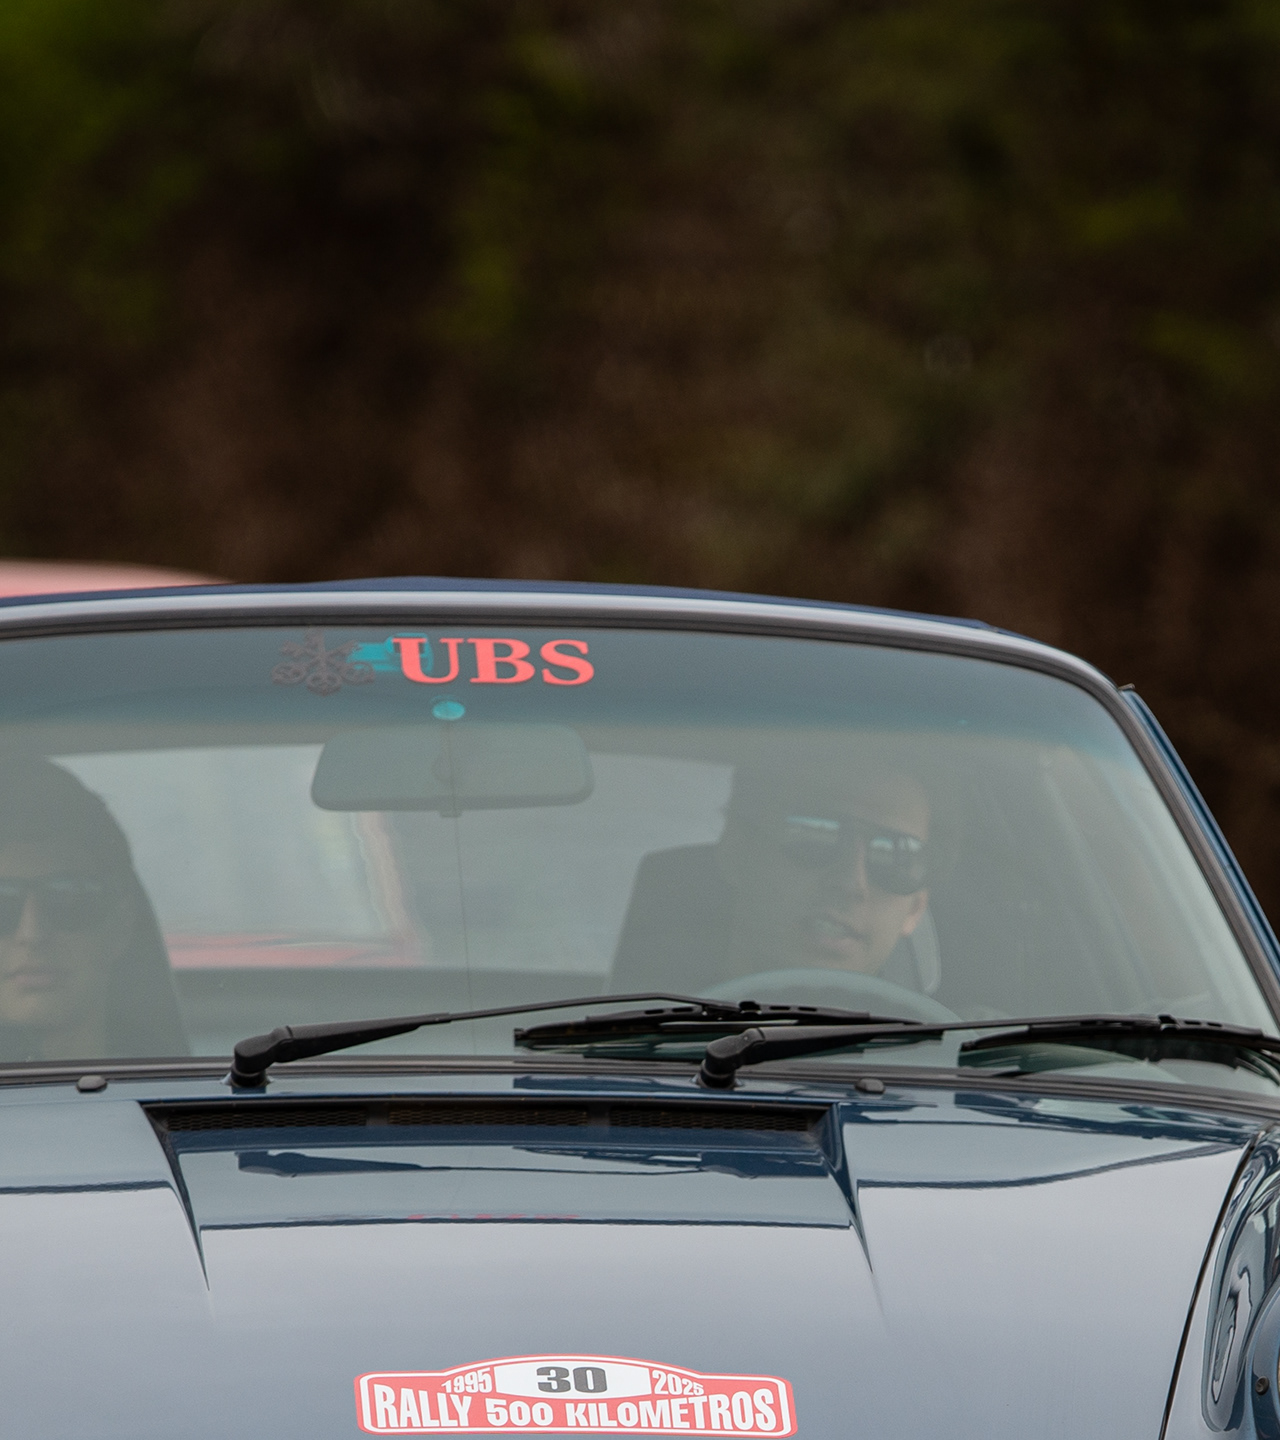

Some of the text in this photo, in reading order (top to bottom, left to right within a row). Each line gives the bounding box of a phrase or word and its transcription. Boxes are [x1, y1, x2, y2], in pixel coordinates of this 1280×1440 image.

[393, 637, 594, 685] UBS
[441, 1366, 705, 1396] 1995 30 2025
[373, 1383, 777, 1432] RALLY 500 KILOMETROS
